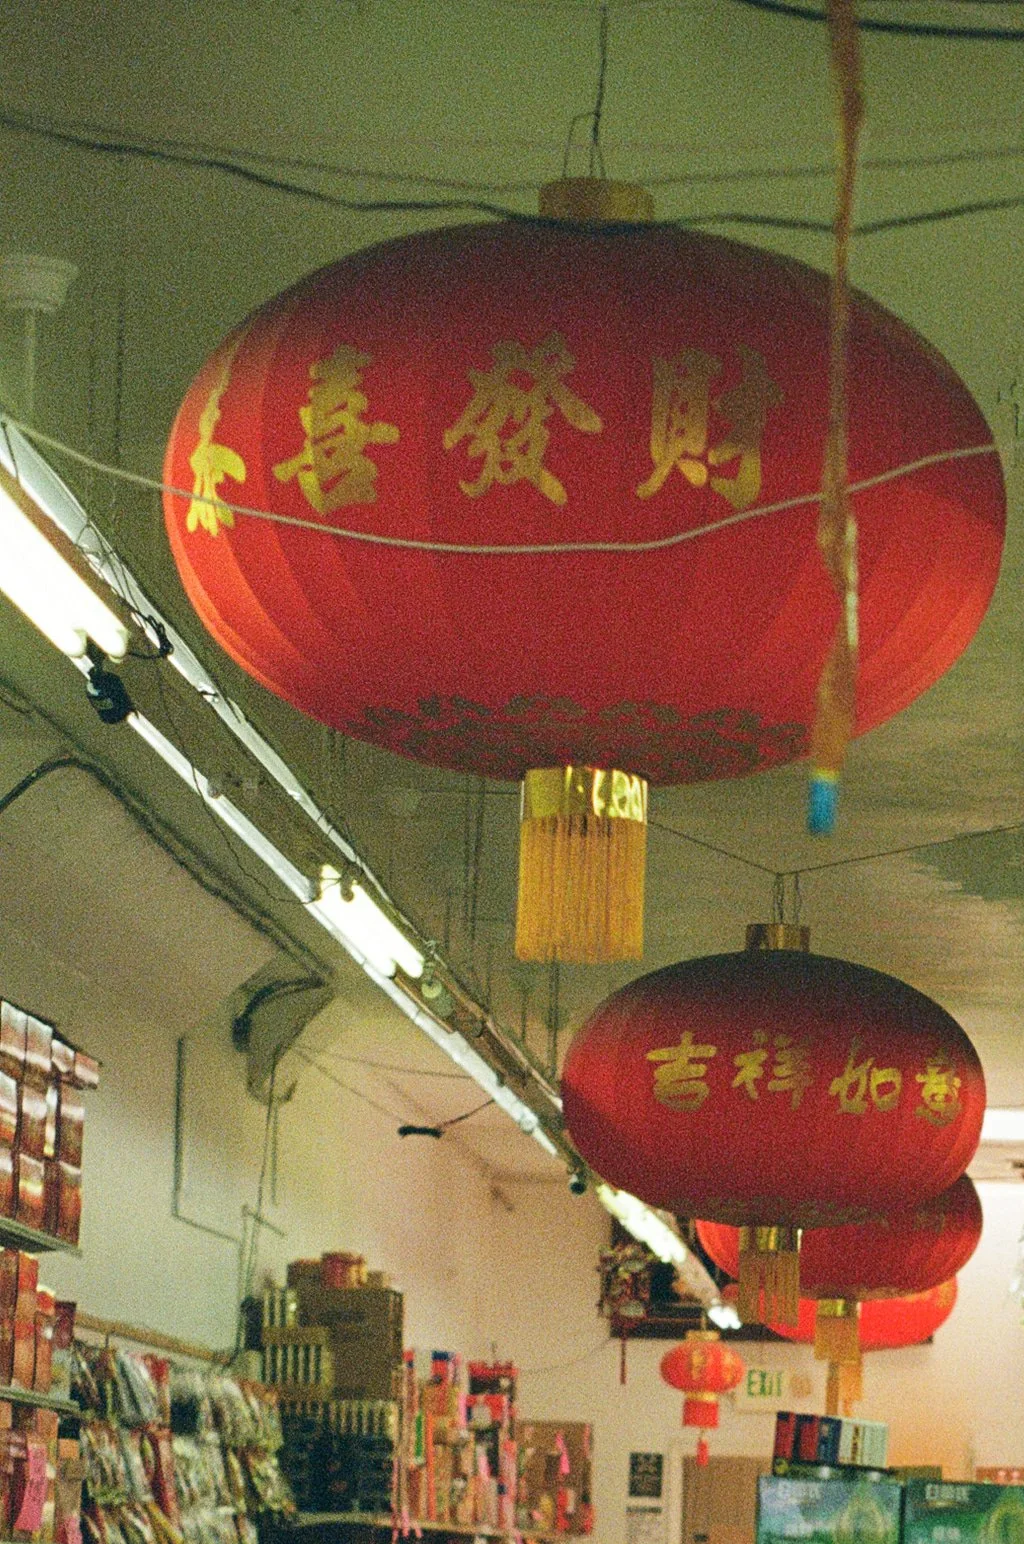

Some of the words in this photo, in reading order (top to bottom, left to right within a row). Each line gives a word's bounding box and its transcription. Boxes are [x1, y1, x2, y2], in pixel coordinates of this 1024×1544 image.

[646, 1028, 964, 1126] 吉祥如意
[747, 1369, 784, 1397] EXIT
